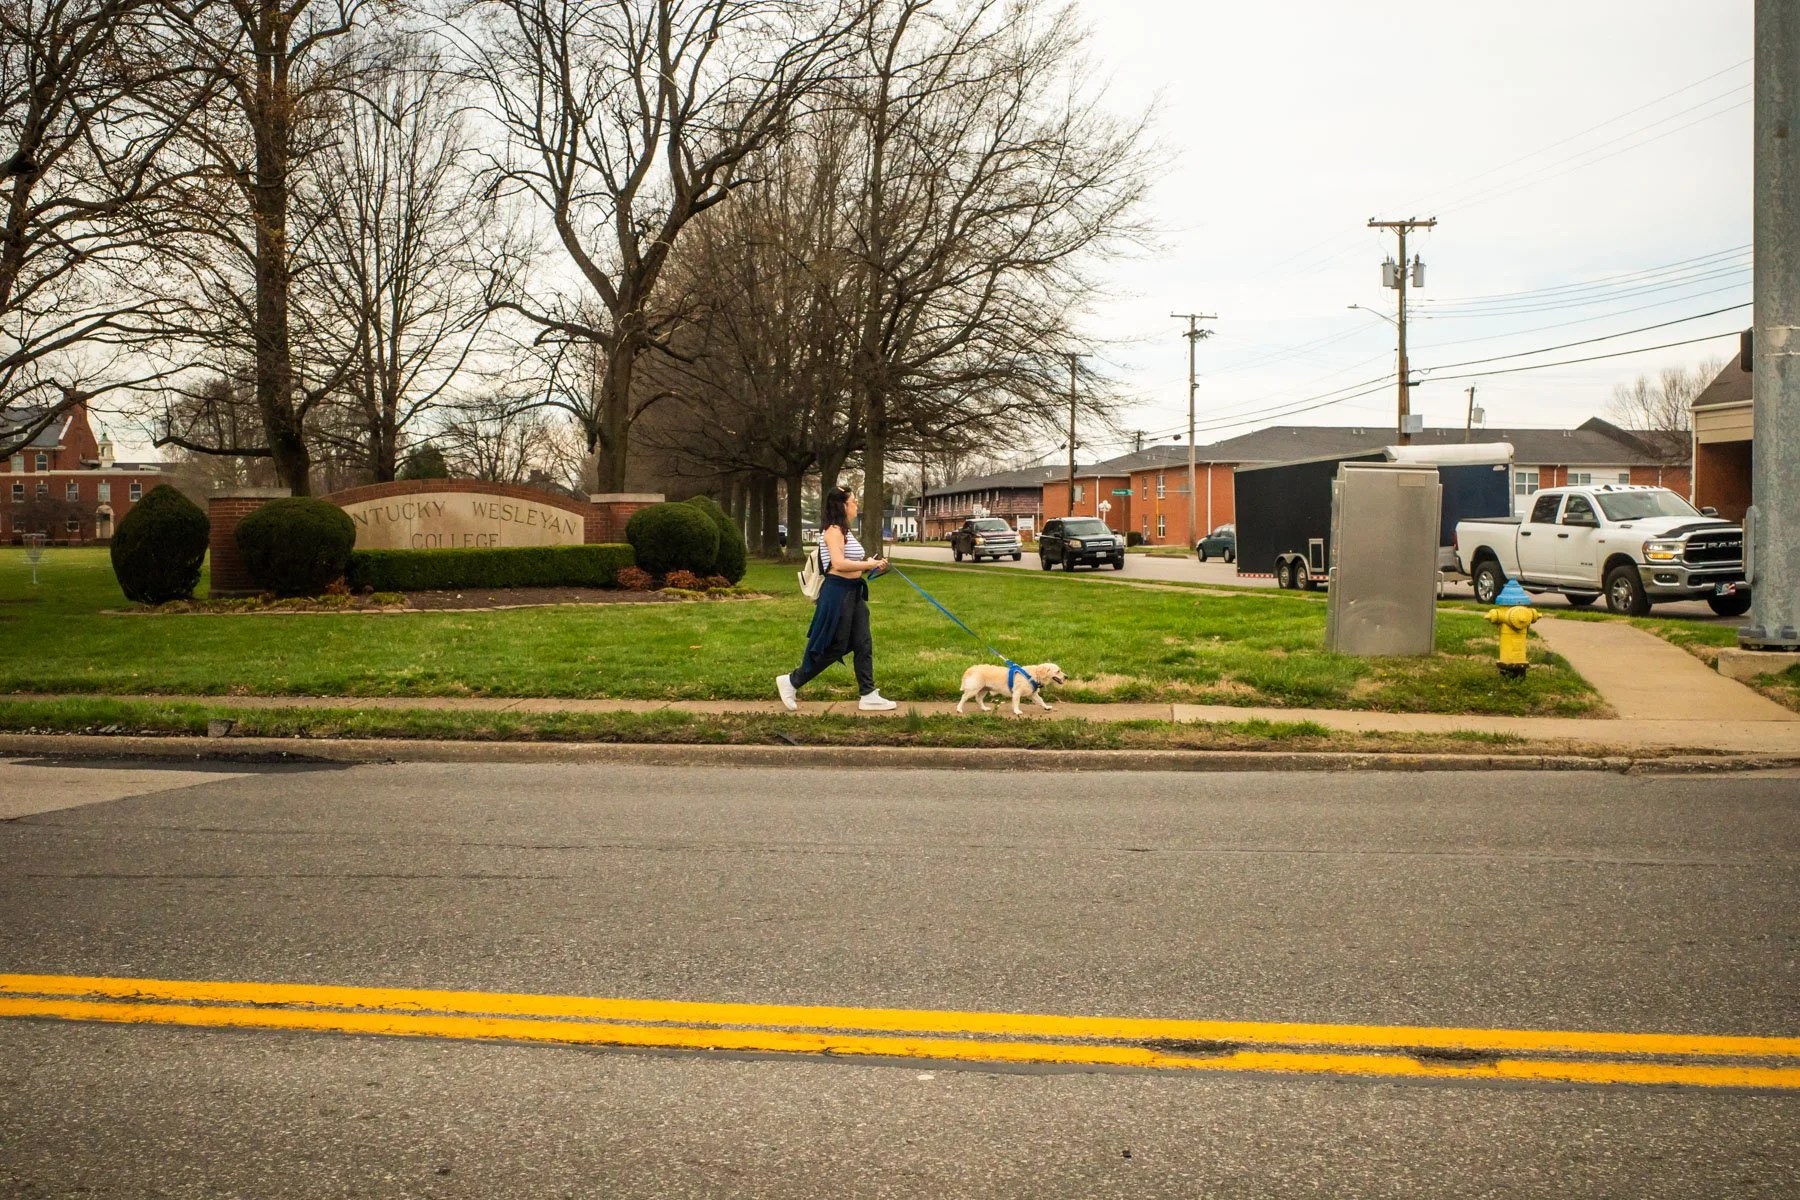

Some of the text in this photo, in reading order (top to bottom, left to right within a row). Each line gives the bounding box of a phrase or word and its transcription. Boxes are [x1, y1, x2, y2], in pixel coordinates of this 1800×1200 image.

[353, 501, 577, 535] NTUCKY WESLEYAN
[1707, 541, 1739, 549] RAM
